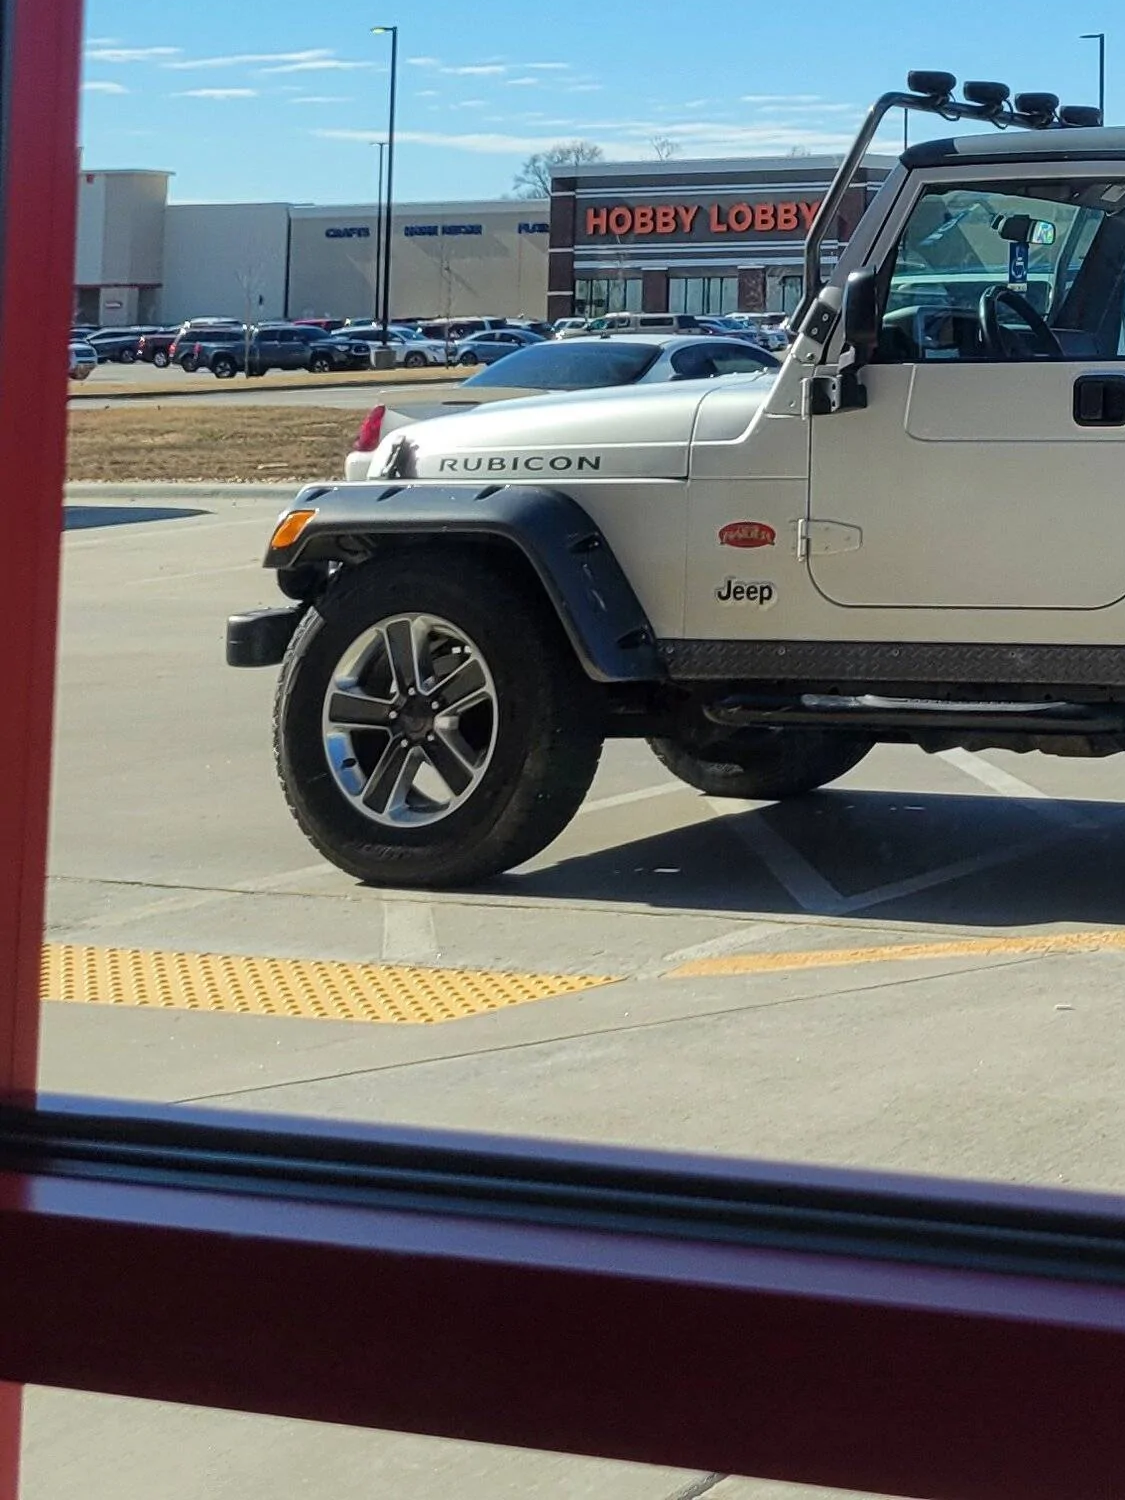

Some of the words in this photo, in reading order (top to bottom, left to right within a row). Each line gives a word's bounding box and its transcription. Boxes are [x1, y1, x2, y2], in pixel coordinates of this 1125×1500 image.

[586, 206, 698, 235] HOBBY
[709, 201, 820, 232] LOBBY
[438, 456, 601, 472] RUBICON
[717, 579, 773, 605] Jeep
